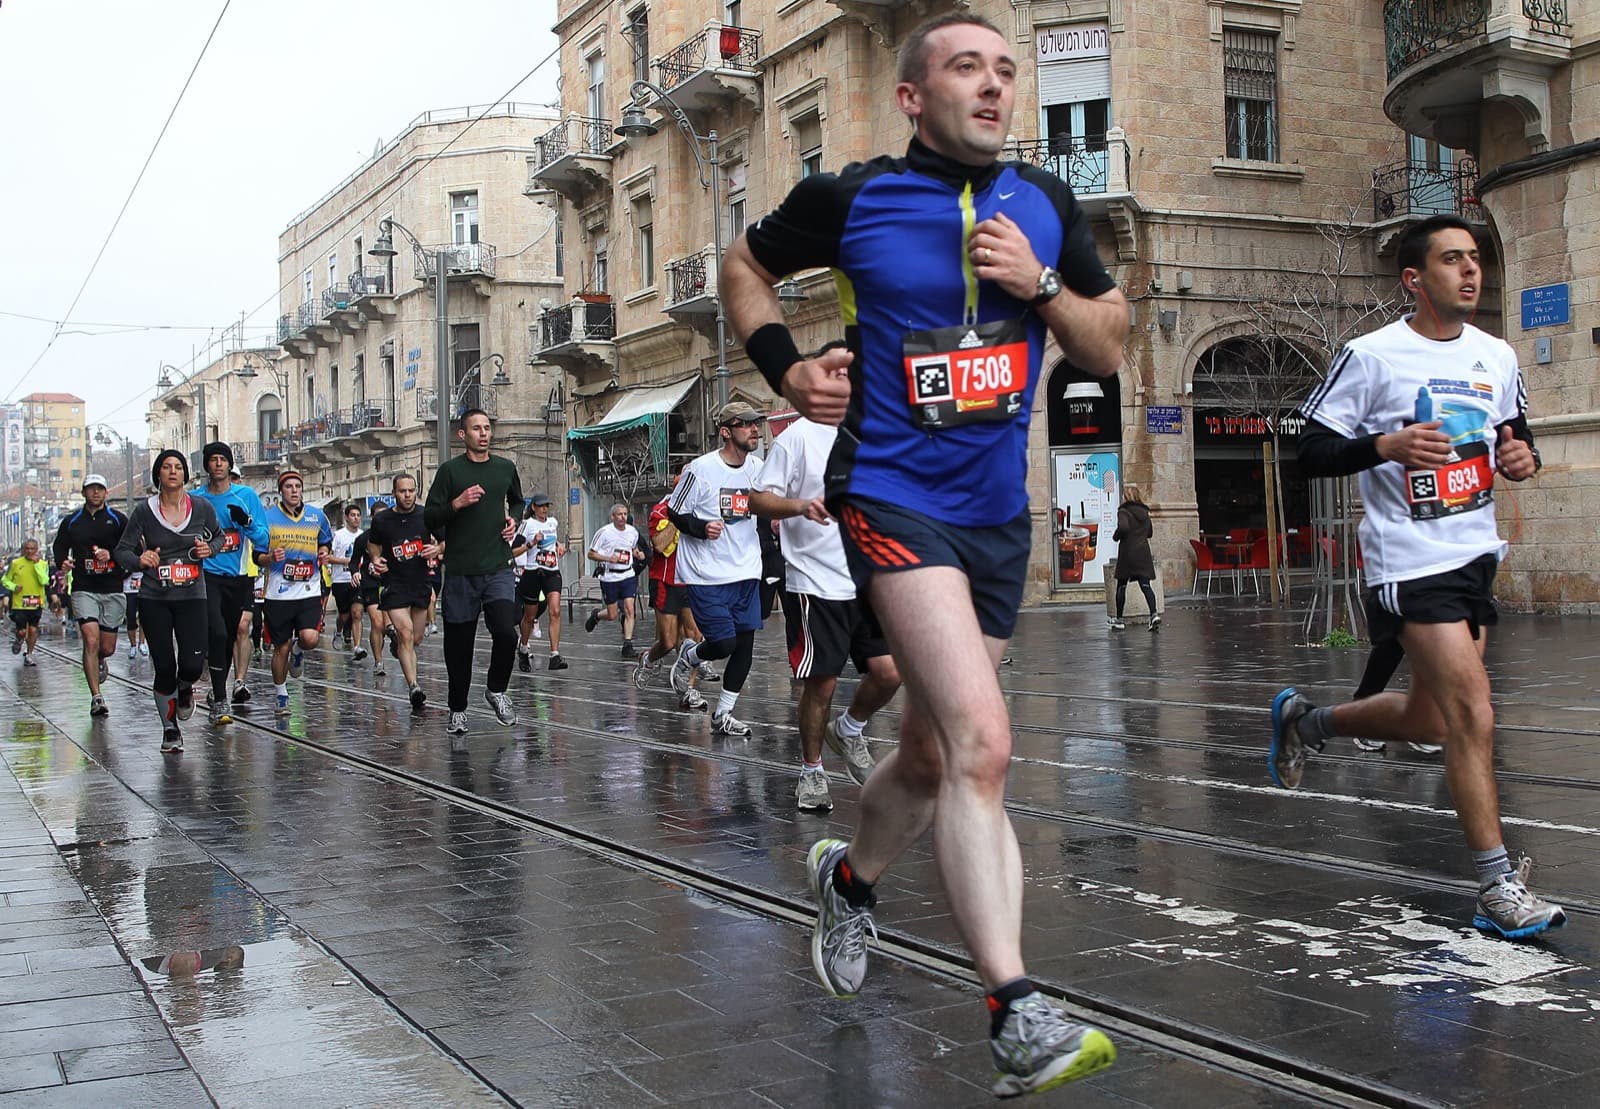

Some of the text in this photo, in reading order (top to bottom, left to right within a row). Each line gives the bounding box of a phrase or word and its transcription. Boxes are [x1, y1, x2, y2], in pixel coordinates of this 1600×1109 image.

[1040, 29, 1107, 54] החוט המשולש
[956, 354, 1013, 393] 7508
[1069, 402, 1093, 414] ארומה
[1205, 416, 1221, 434] בר
[1448, 465, 1480, 493] 6934
[175, 567, 192, 578] 6075
